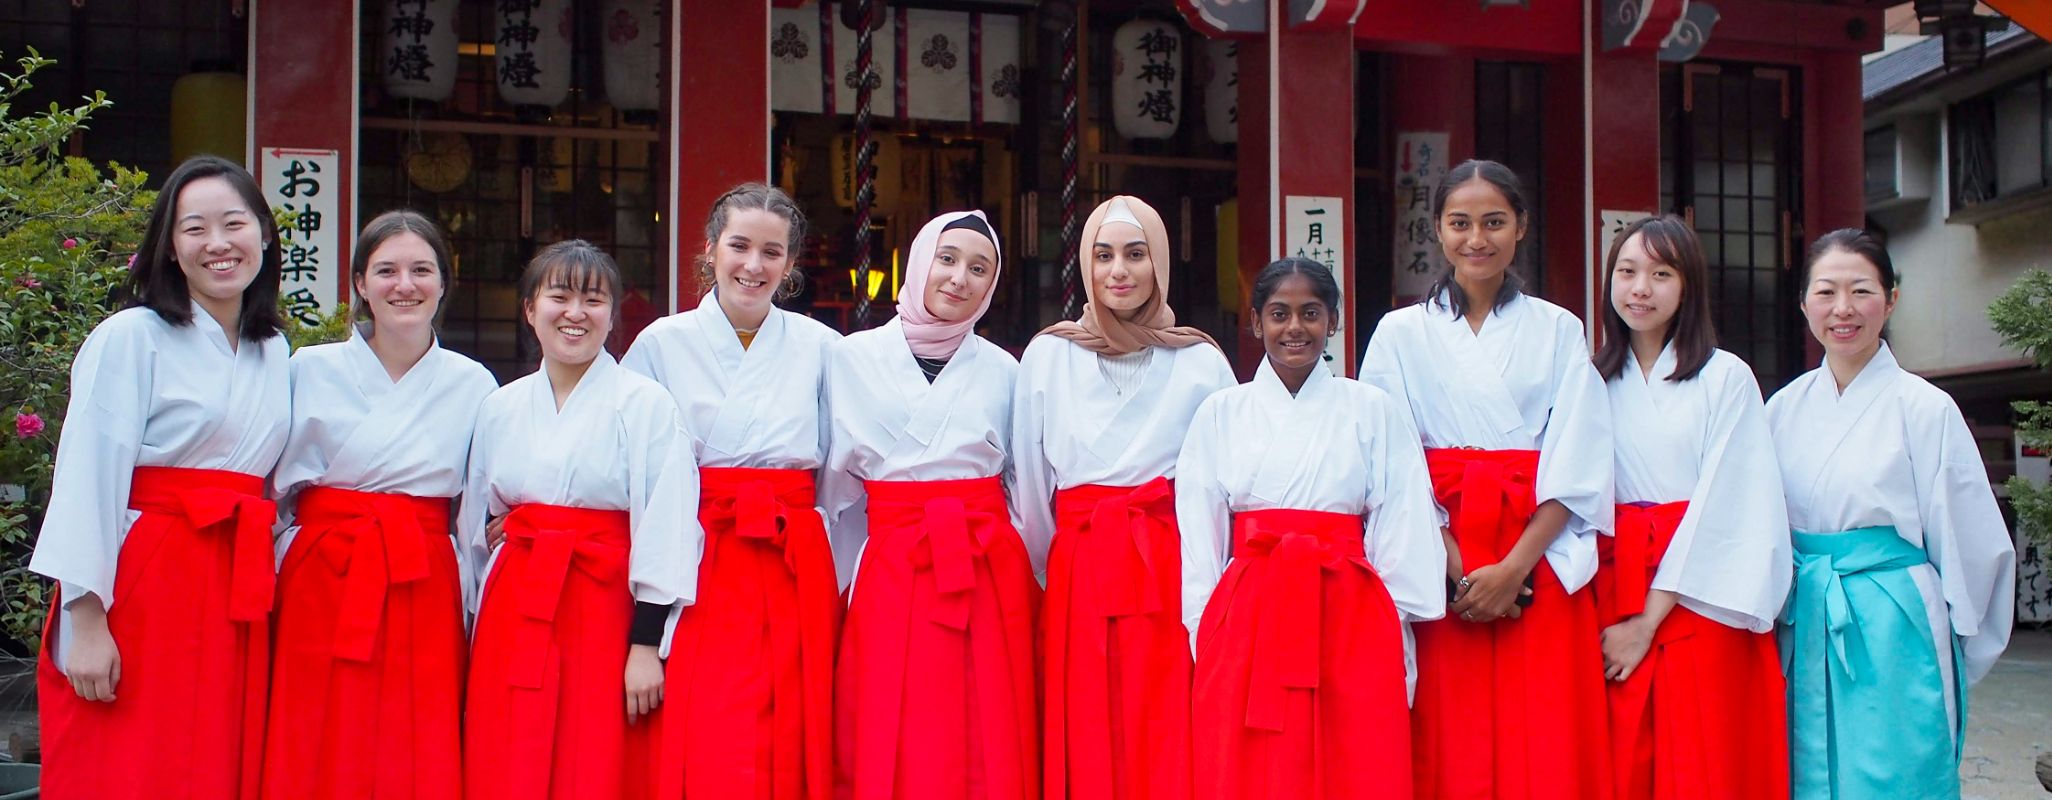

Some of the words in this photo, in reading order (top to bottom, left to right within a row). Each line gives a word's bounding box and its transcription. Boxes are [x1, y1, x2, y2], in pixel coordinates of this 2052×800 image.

[1136, 26, 1177, 124] 御神燈
[1305, 208, 1325, 244] 一月
